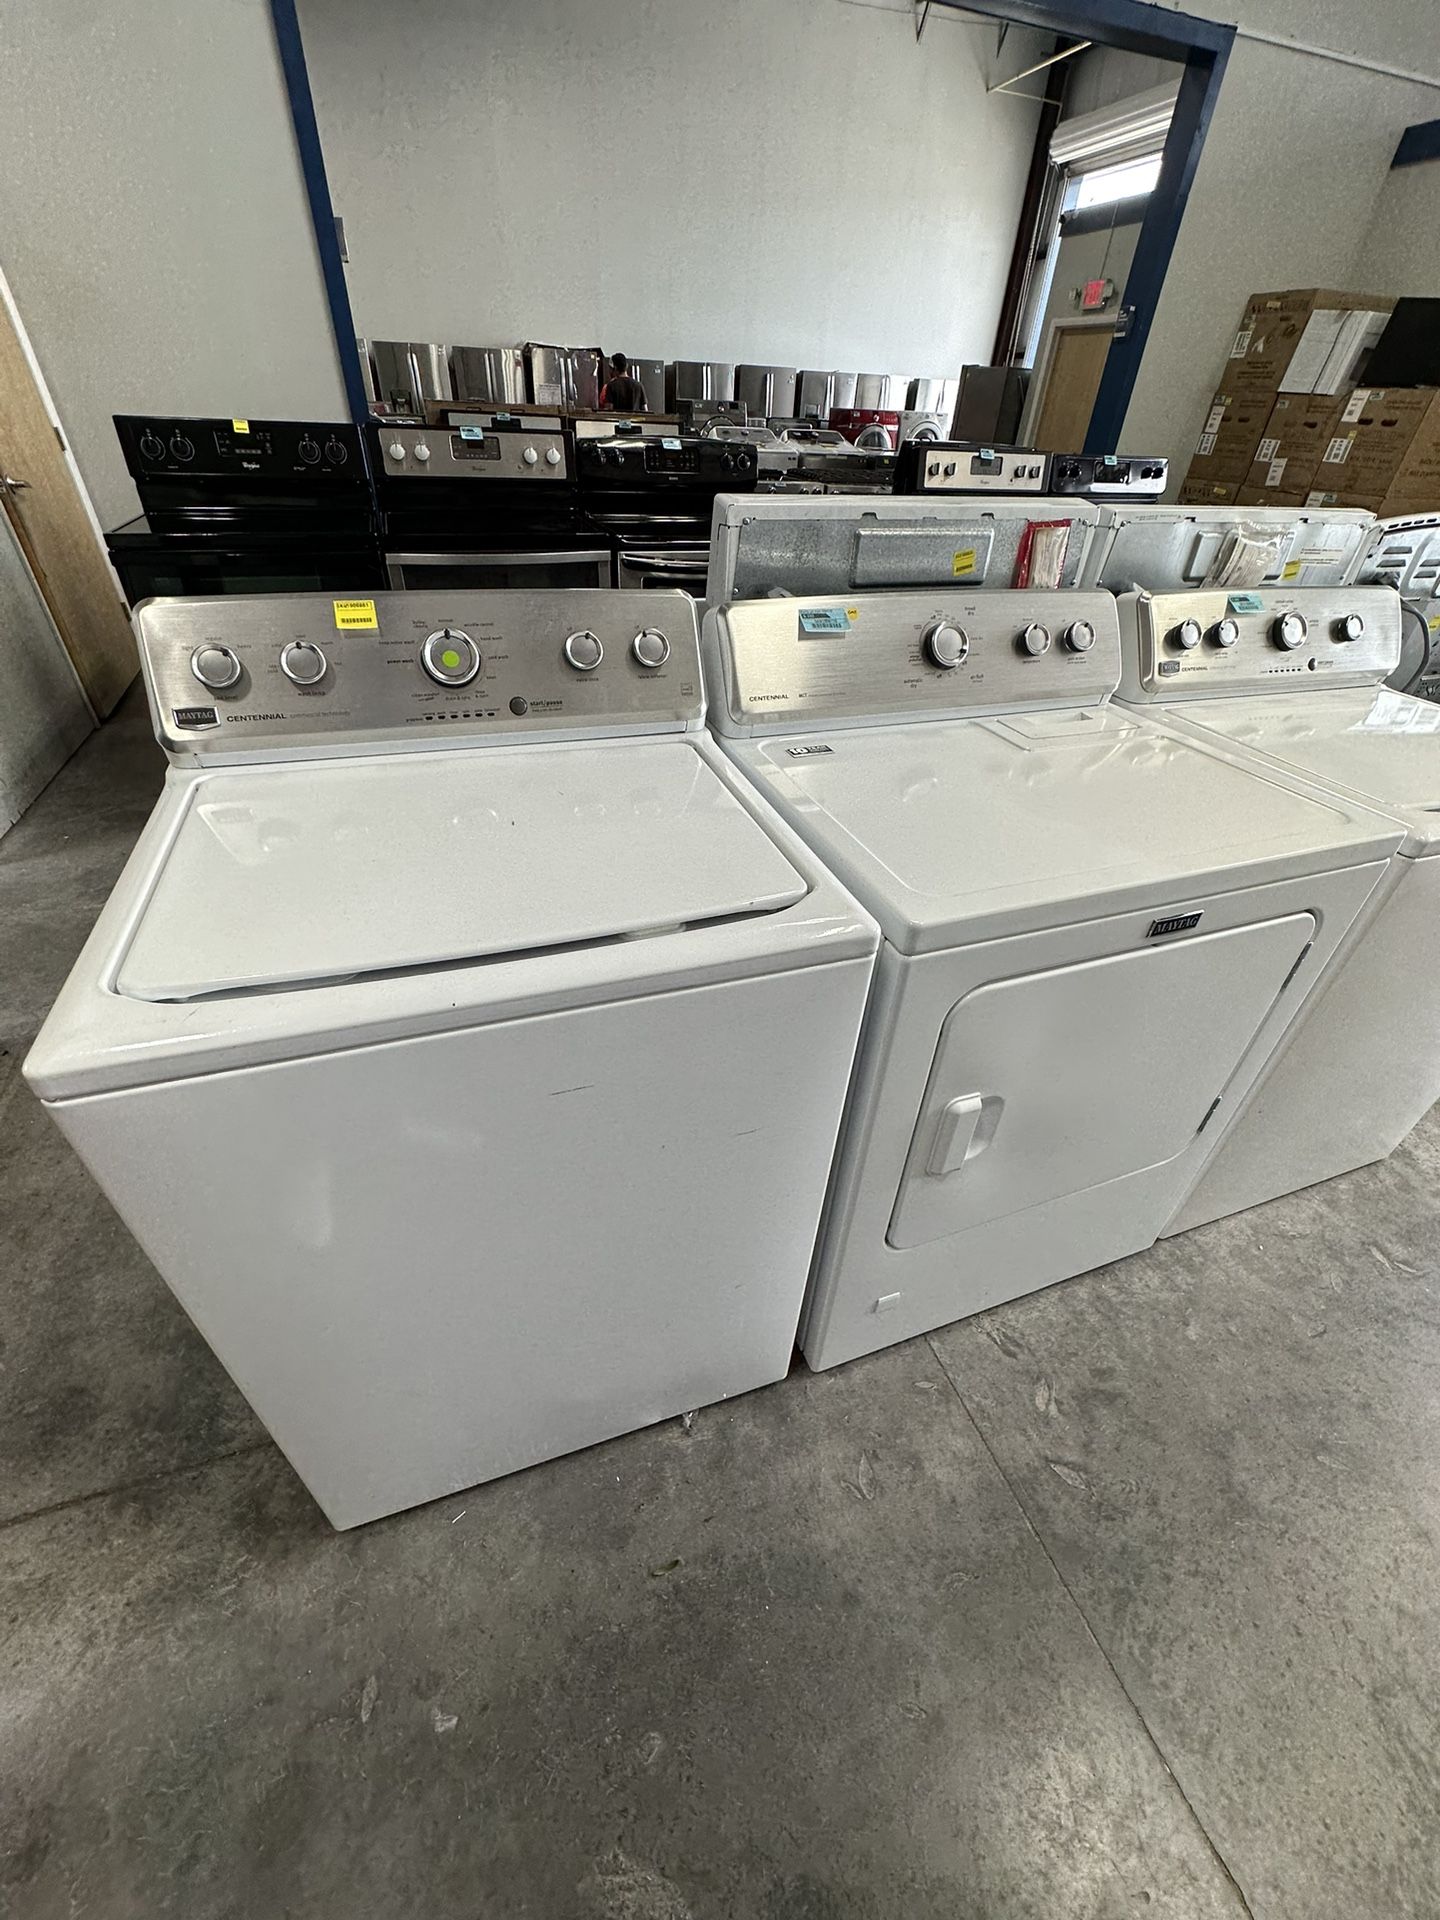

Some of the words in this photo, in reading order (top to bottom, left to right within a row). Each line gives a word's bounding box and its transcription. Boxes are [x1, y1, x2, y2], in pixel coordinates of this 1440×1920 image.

[749, 694, 789, 702] CENTENNIAL
[178, 710, 214, 720] MAYTAG
[226, 713, 287, 723] CENTENNIAL
[1154, 915, 1199, 934] MAYTAG
